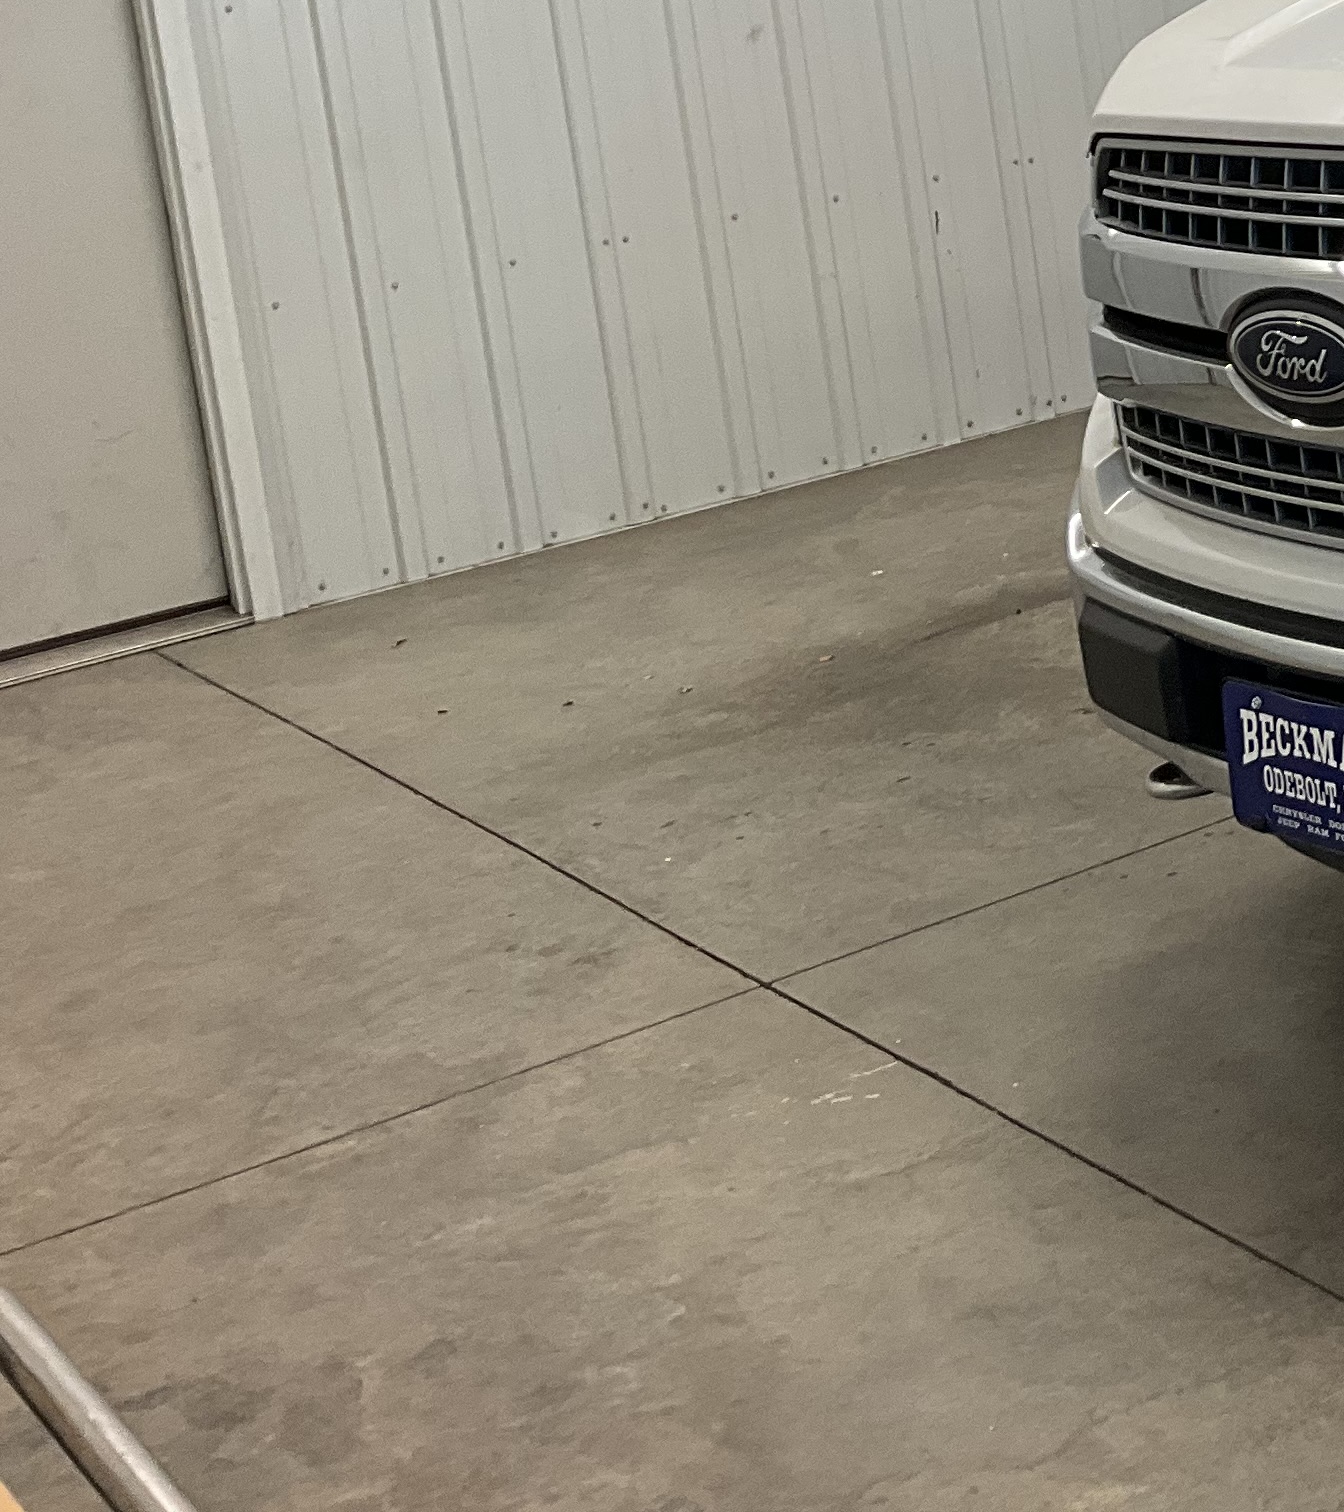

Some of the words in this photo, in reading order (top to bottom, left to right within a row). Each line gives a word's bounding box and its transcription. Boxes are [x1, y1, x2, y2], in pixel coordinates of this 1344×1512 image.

[1256, 330, 1328, 383] Ford
[1263, 764, 1341, 814] ODEBOLT,
[1272, 804, 1323, 825] CHRYSLER
[1307, 824, 1330, 838] RAM
